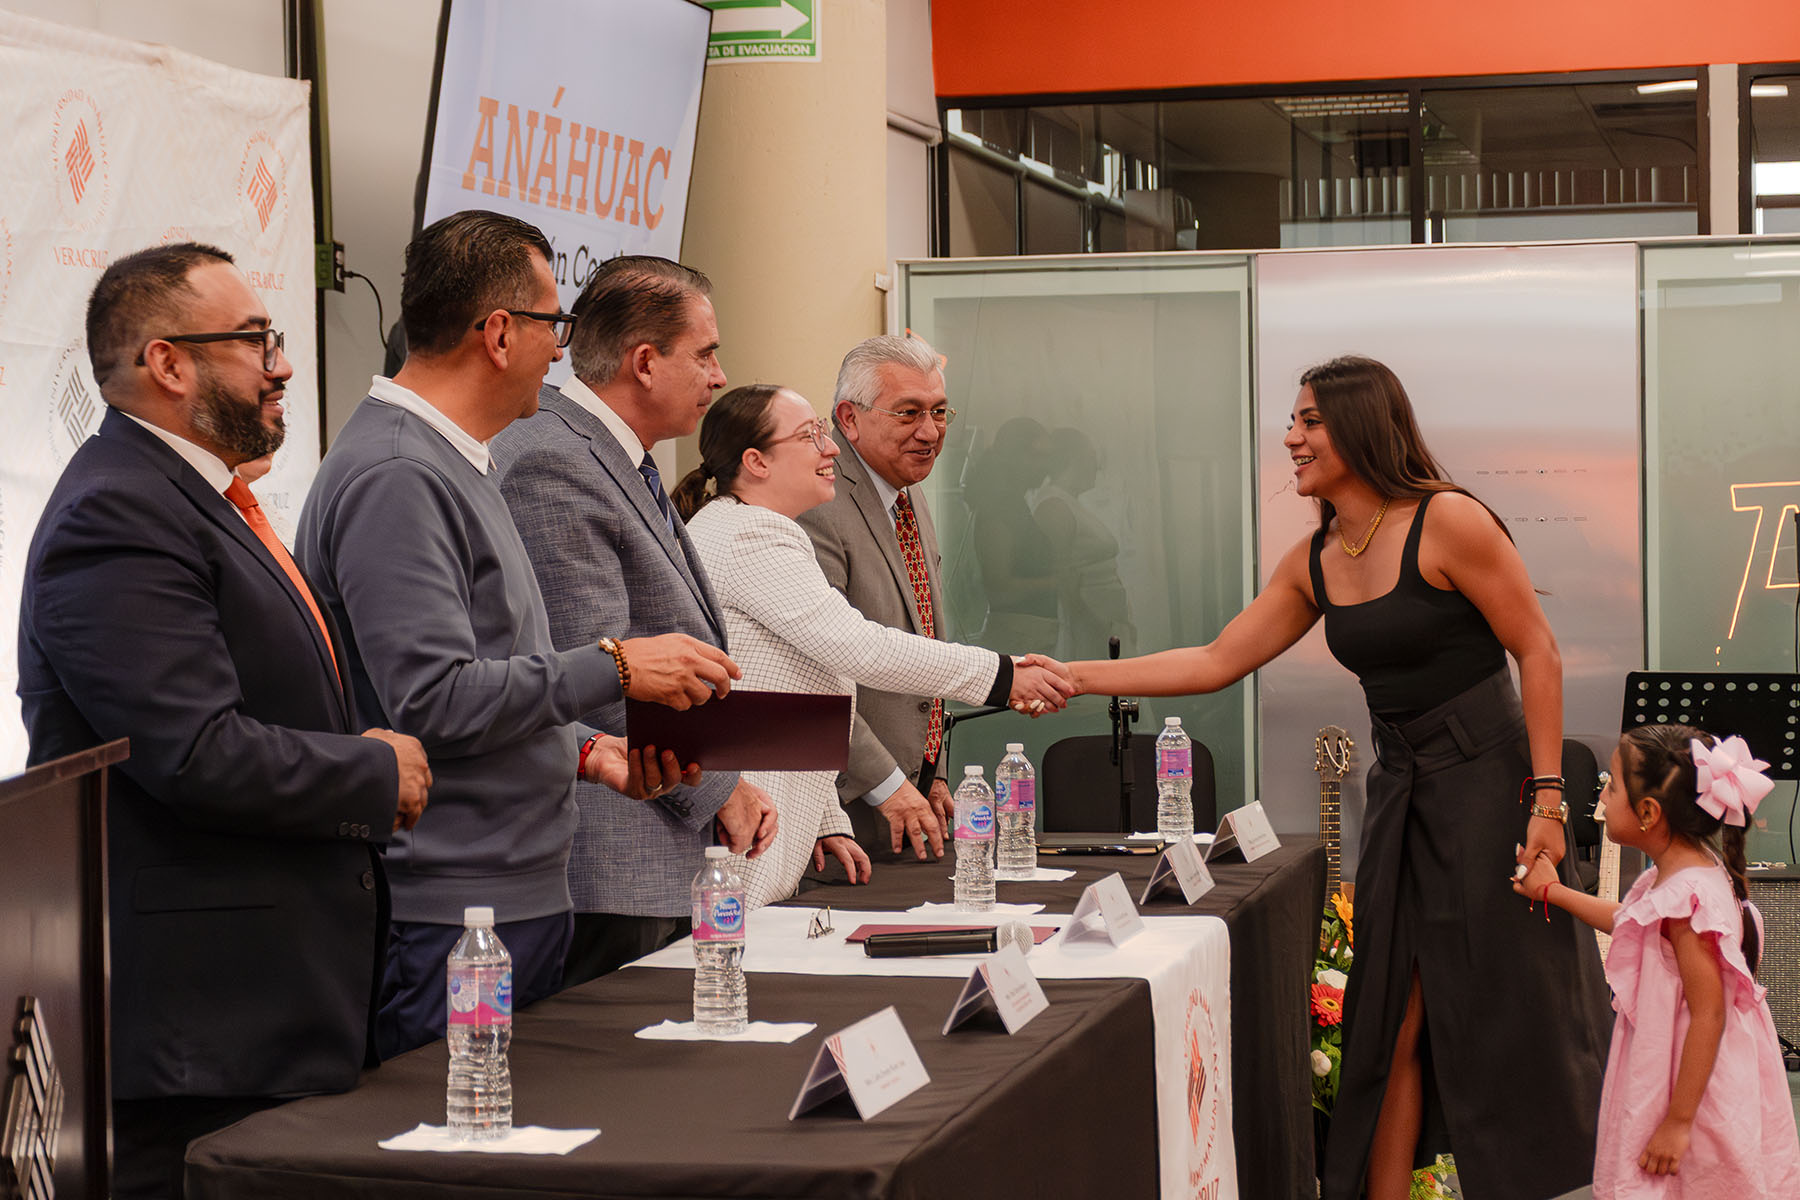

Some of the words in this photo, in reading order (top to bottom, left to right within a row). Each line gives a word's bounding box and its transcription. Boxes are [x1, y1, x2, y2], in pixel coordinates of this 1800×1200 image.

[722, 45, 735, 56] DE
[738, 44, 810, 55] EVACUACION
[461, 86, 672, 231] ANÁHUAC
[53, 246, 109, 270] VERACRUZ
